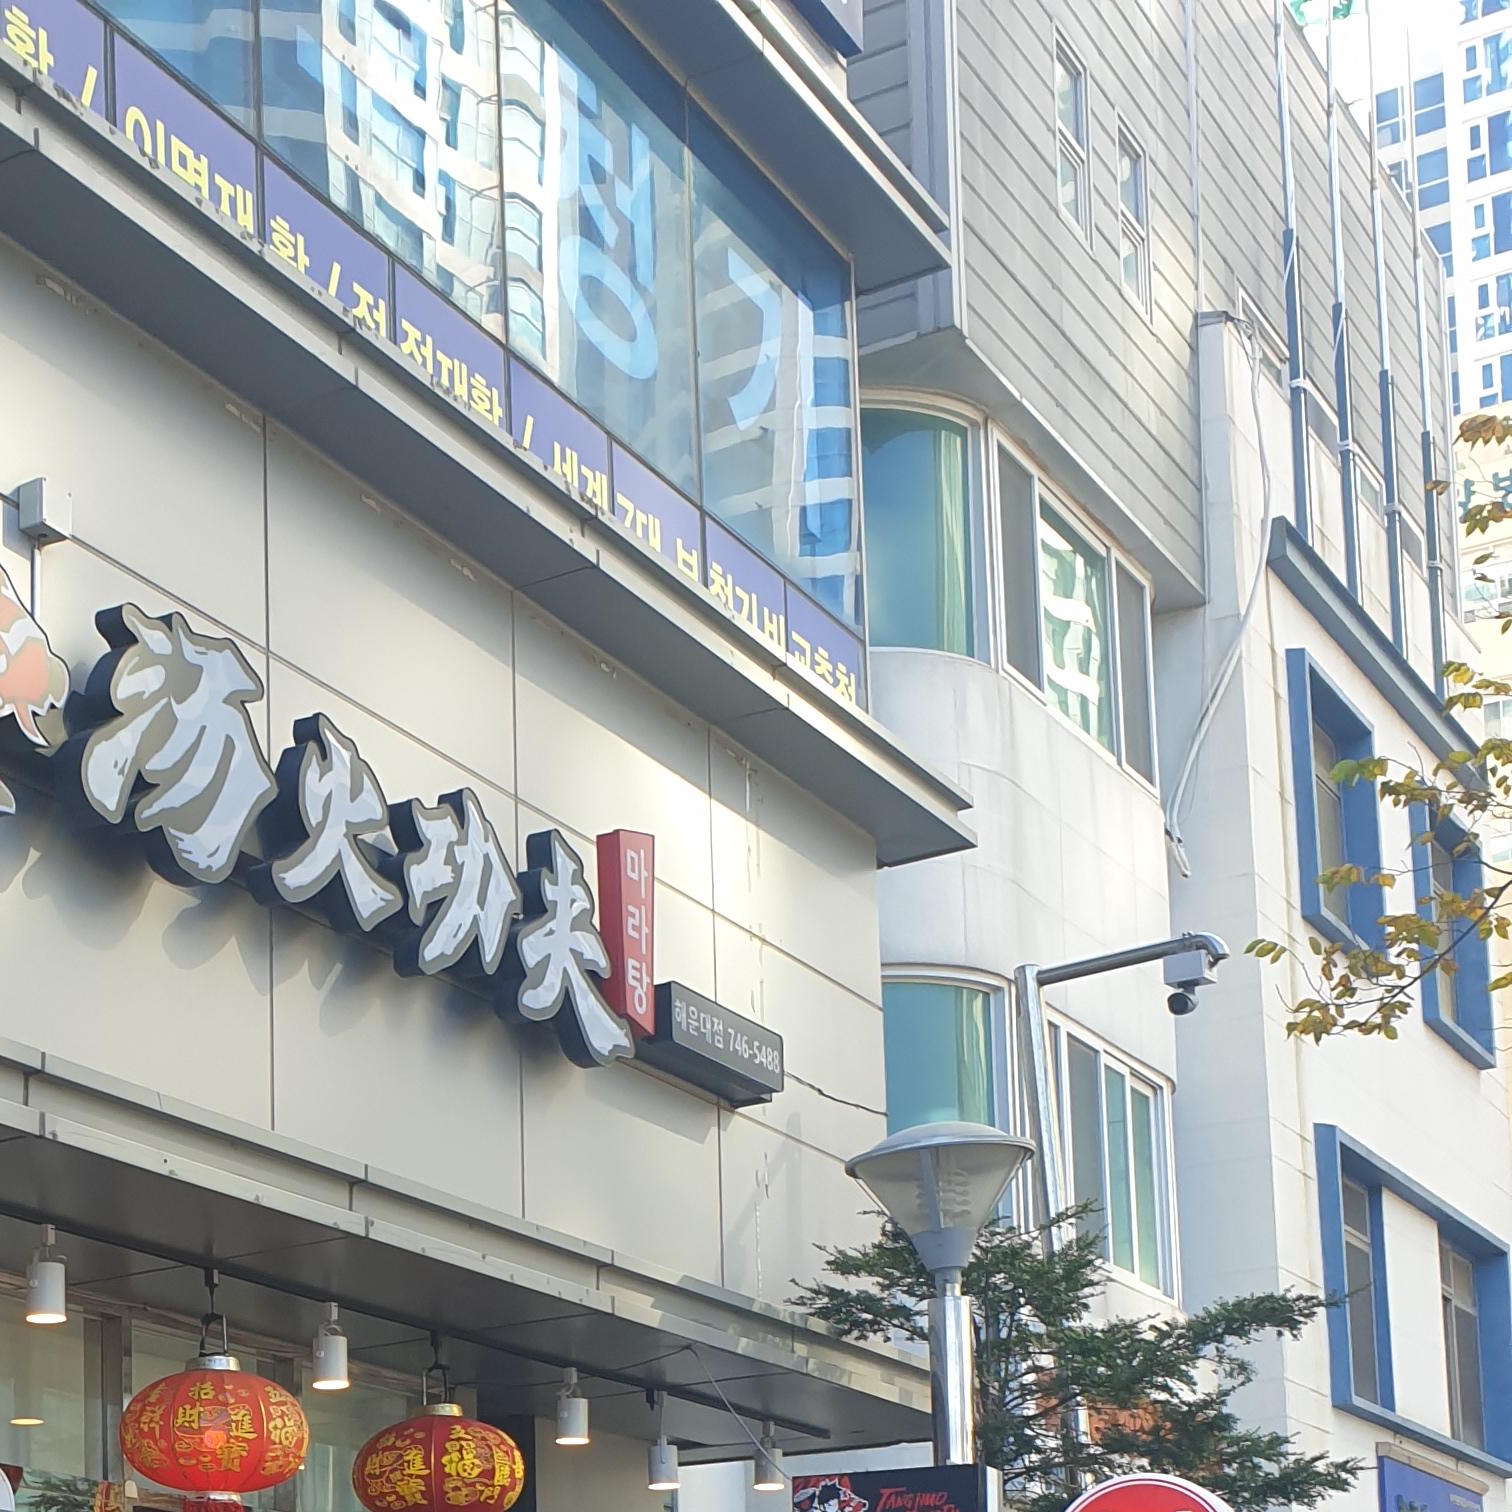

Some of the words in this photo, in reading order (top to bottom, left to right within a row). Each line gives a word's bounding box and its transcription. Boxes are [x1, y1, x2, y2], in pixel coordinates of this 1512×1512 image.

[625, 848, 650, 1016] 마라탕
[674, 999, 724, 1049] 해운대점
[727, 1027, 780, 1074] 746-5488
